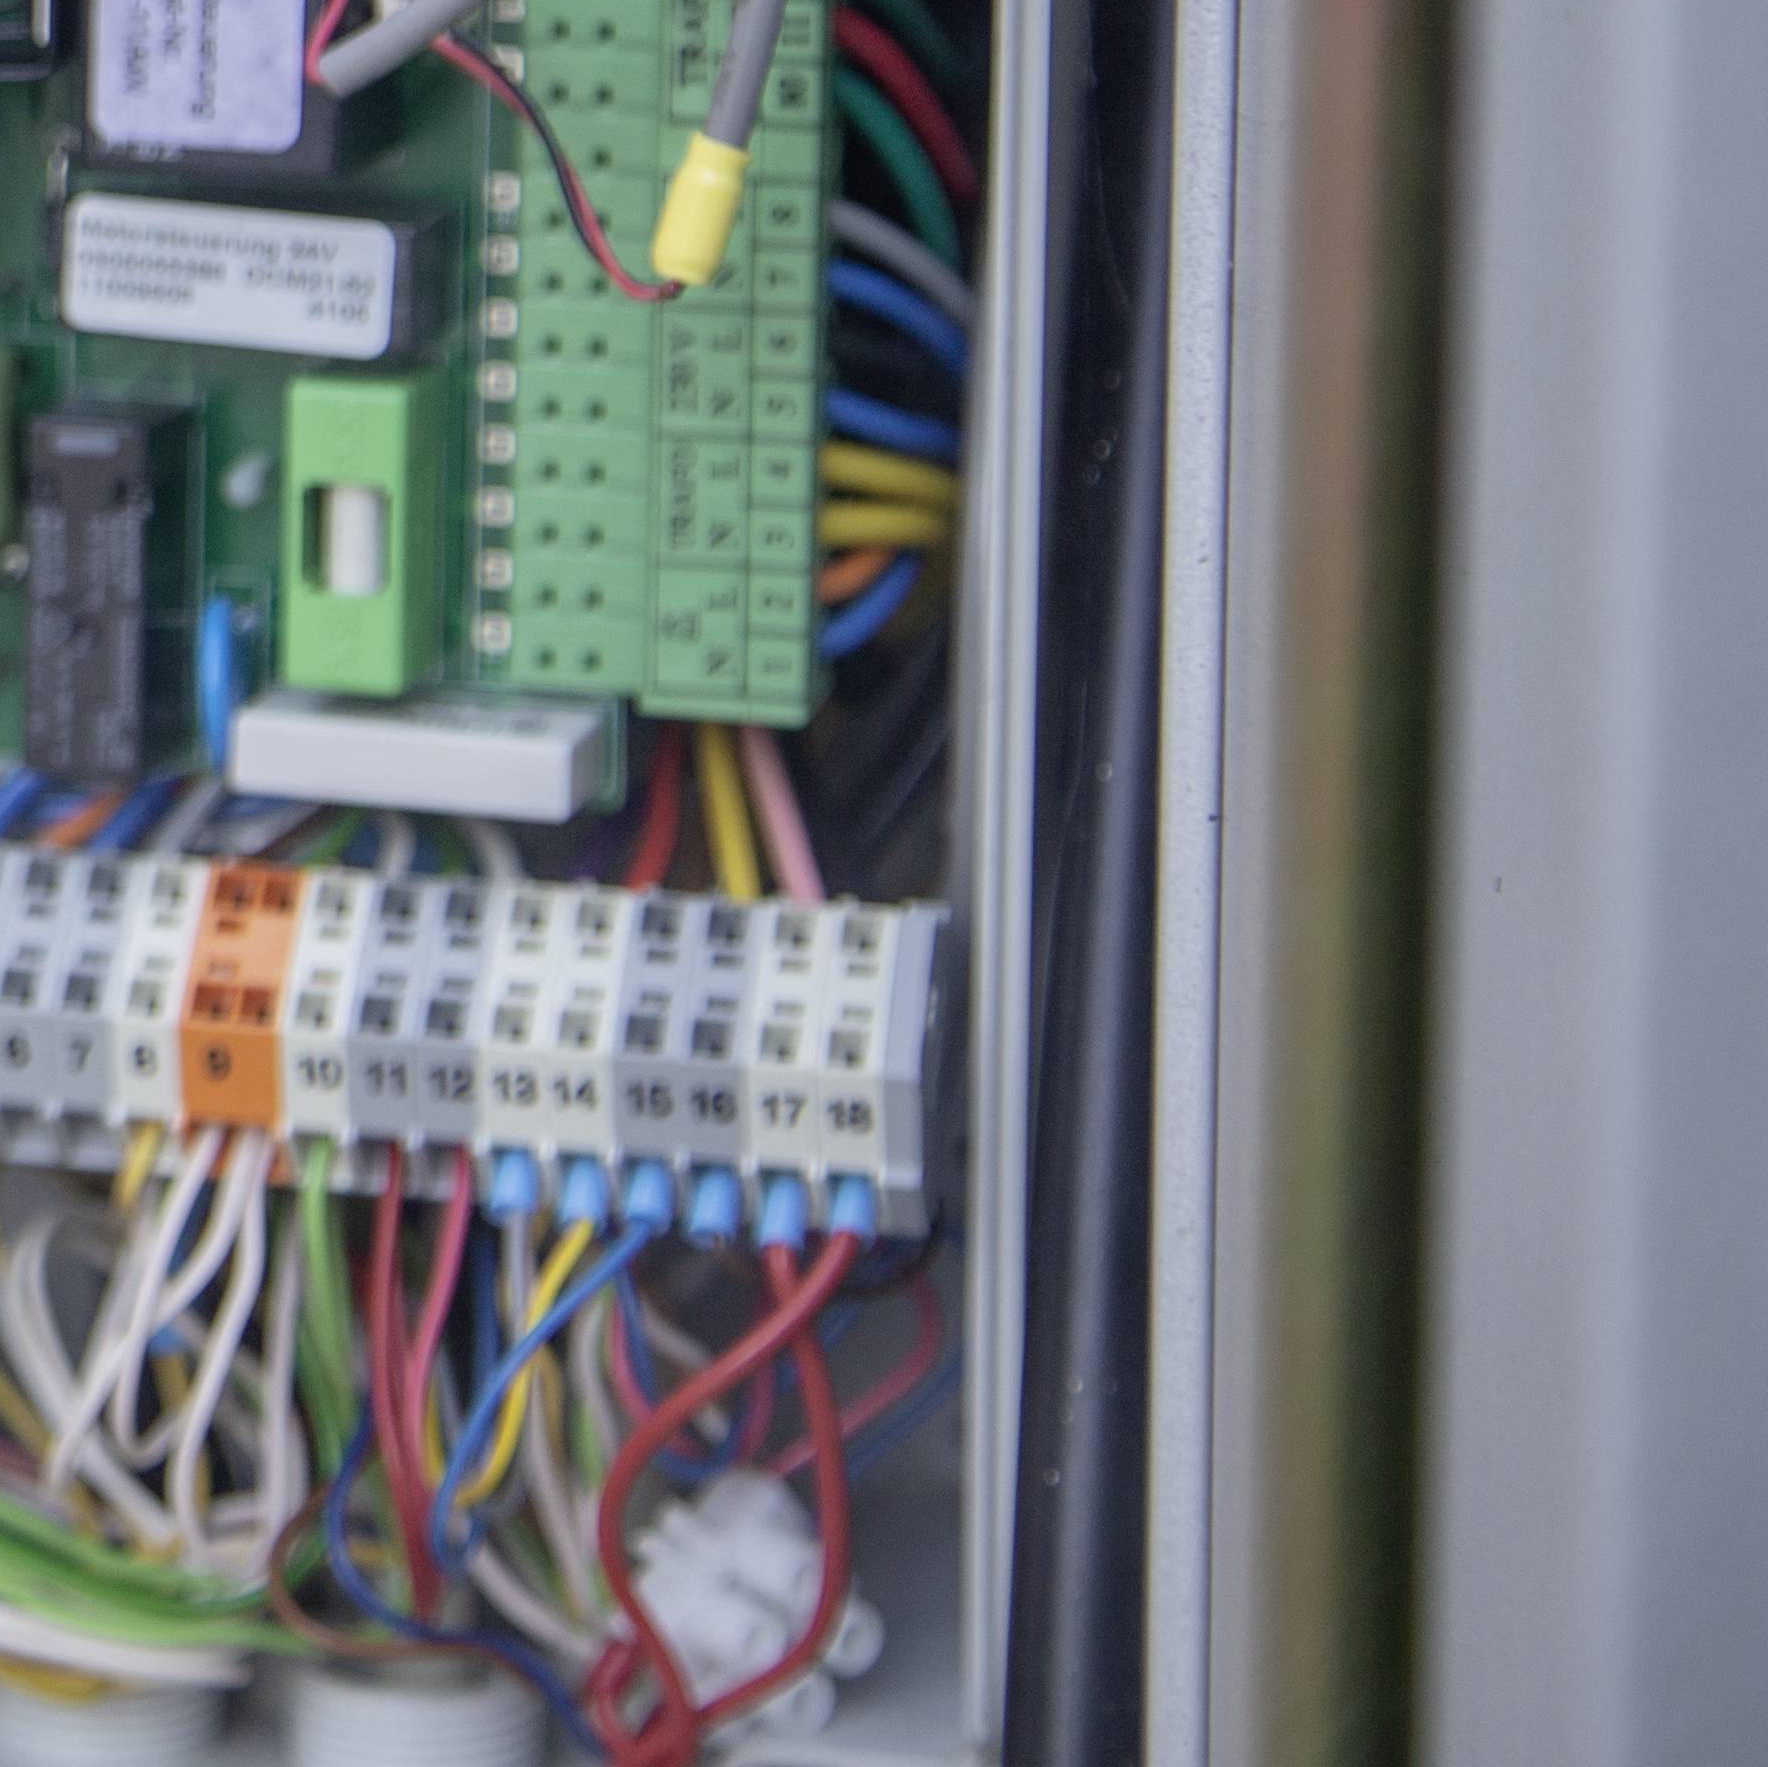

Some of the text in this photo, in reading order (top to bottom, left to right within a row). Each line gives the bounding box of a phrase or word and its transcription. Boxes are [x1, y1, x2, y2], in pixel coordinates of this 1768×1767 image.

[2, 1033, 31, 1069] 6
[68, 1036, 96, 1070] 7
[131, 1043, 157, 1076] 8
[205, 1046, 232, 1081] 9
[297, 1056, 343, 1090] 10
[366, 1063, 408, 1096] 11
[429, 1066, 475, 1100] 12
[494, 1070, 539, 1104] 13
[553, 1076, 599, 1111] 14
[626, 1083, 672, 1117] 15
[690, 1089, 738, 1124] 16
[761, 1094, 807, 1125] 17
[827, 1098, 873, 1131] 18
